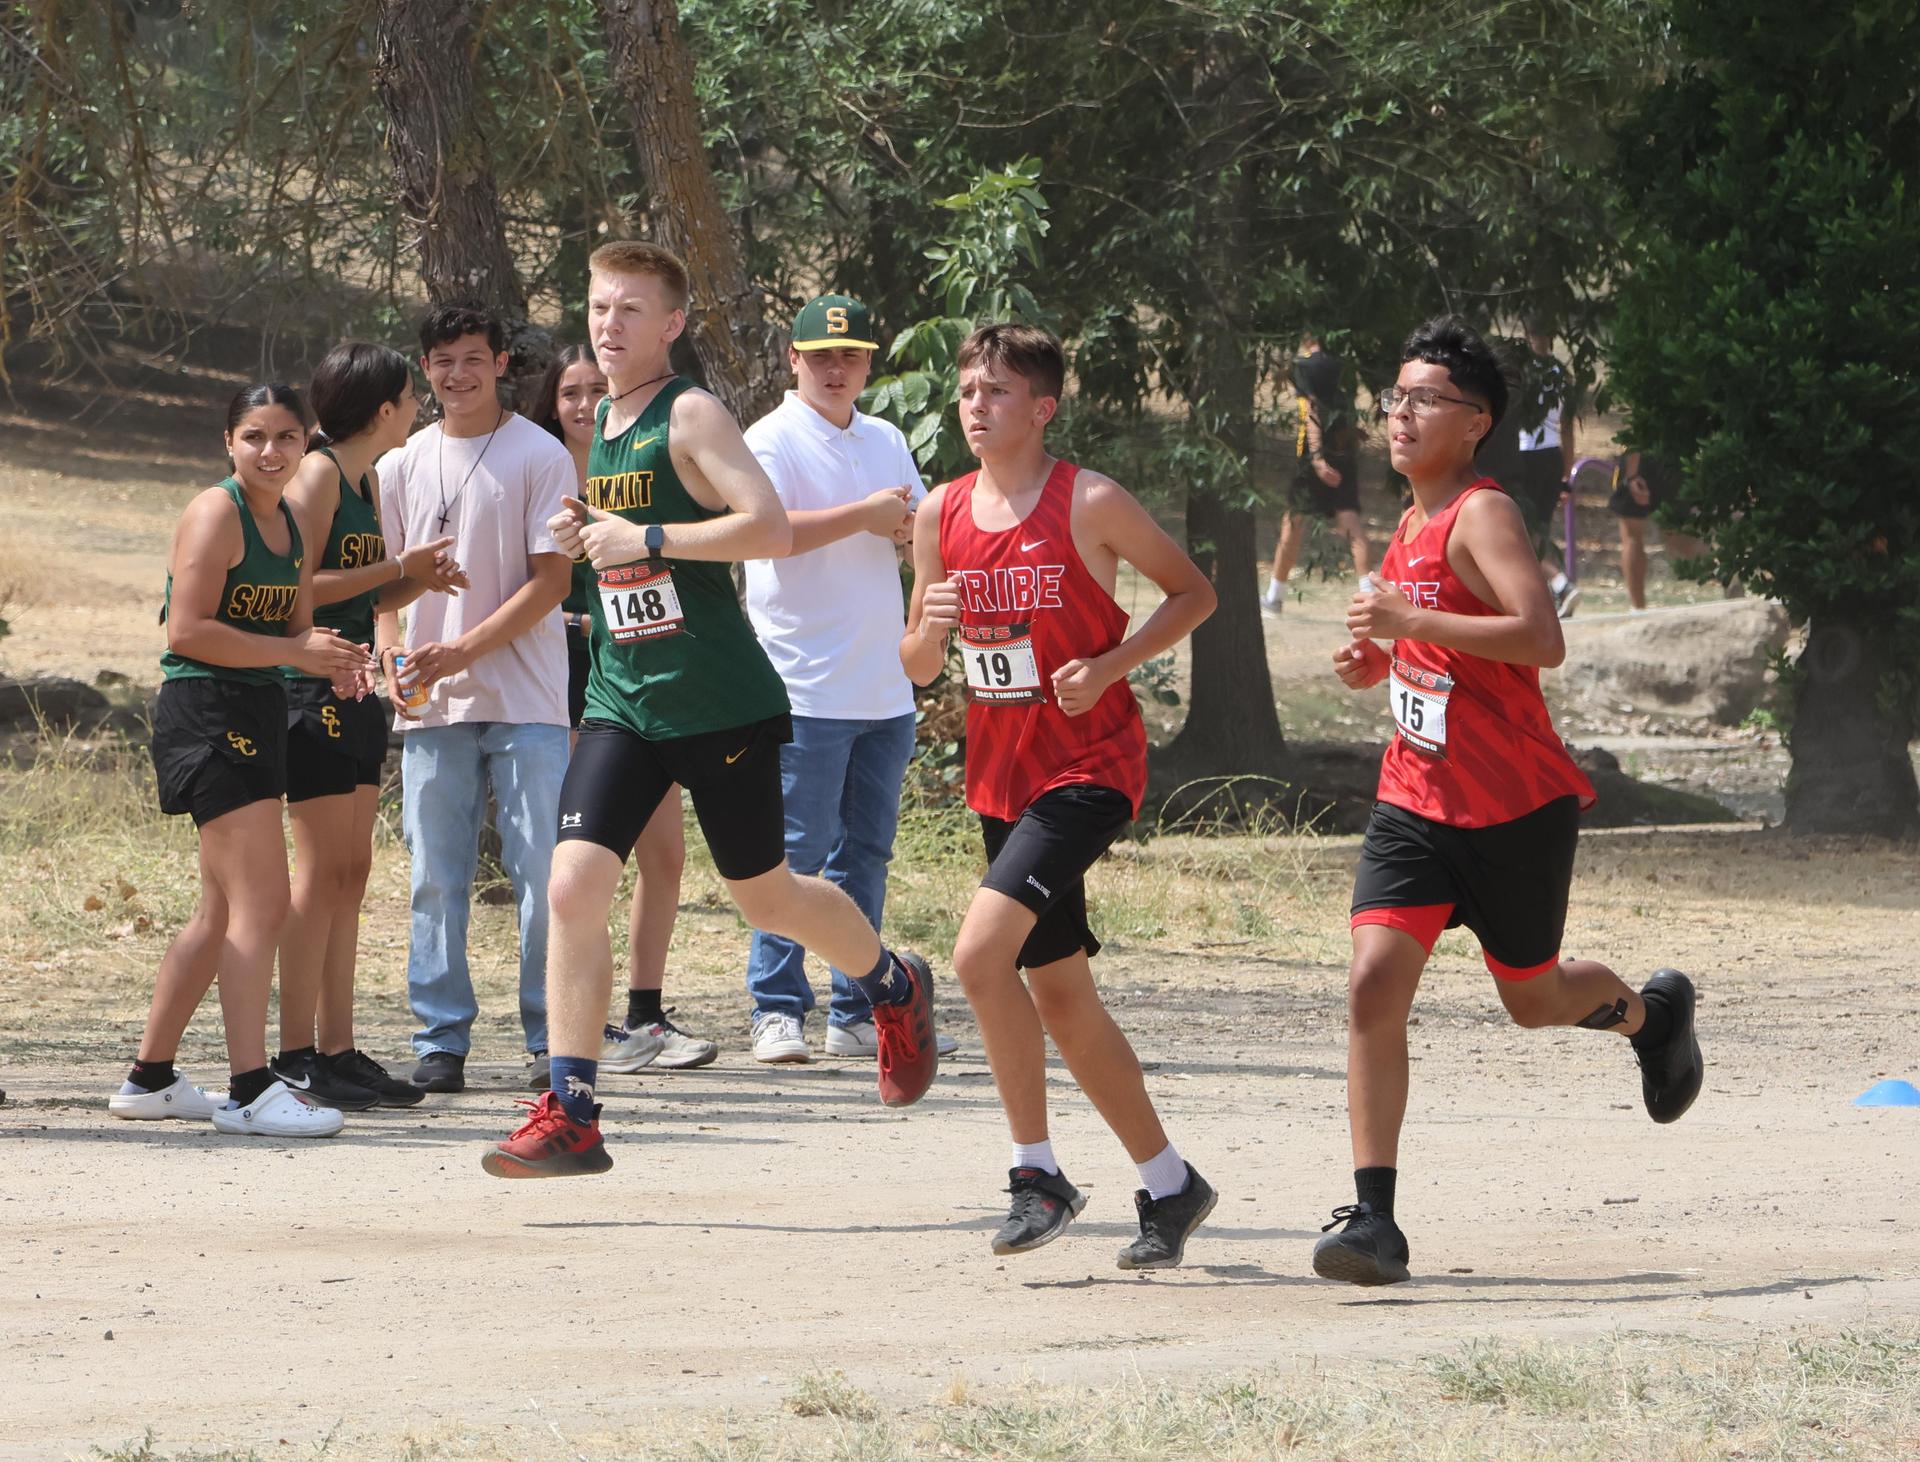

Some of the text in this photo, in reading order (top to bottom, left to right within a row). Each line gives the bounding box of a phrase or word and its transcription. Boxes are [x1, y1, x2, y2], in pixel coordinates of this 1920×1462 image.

[826, 306, 849, 334] S
[610, 589, 666, 627] 148
[614, 623, 677, 640] RACE TIMING
[975, 652, 1012, 687] 19
[975, 690, 1033, 699] RACE TIMING
[322, 705, 341, 738] SC
[1399, 690, 1425, 732] 15
[226, 731, 257, 756] SC
[1406, 732, 1438, 752] TIMING
